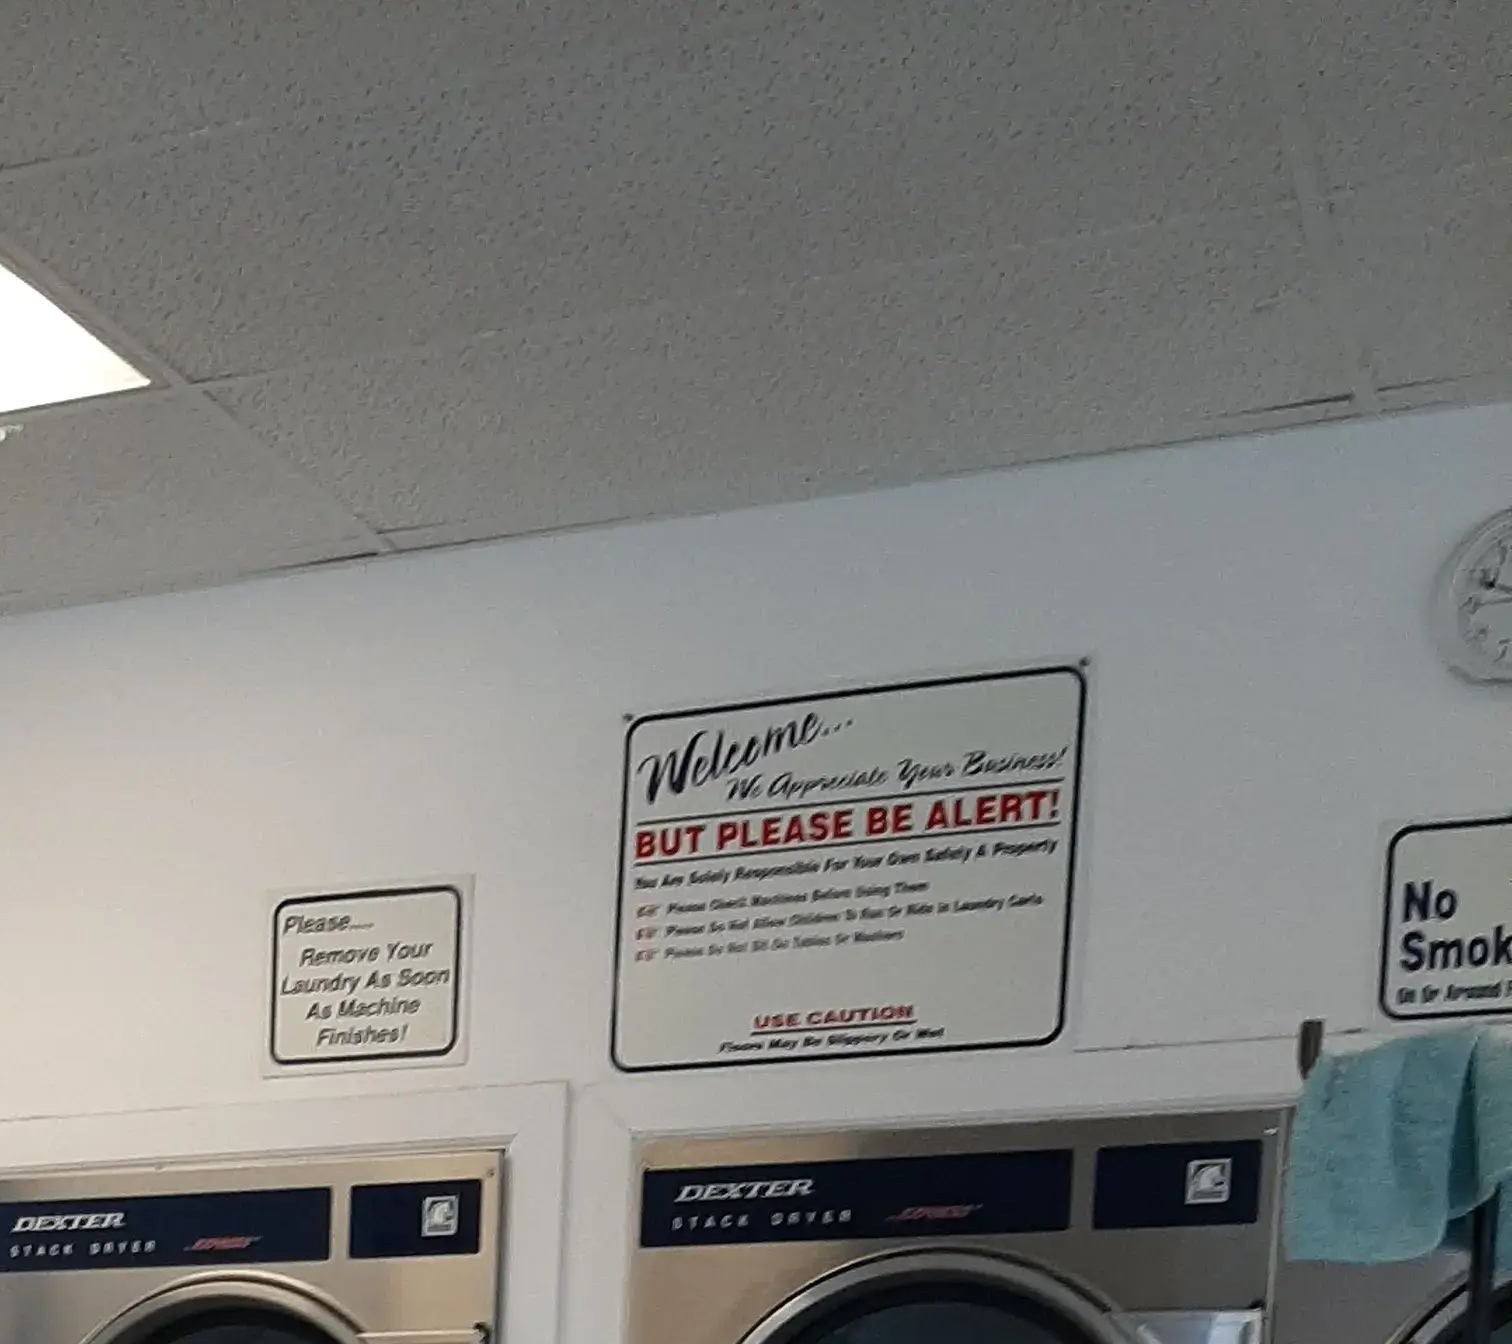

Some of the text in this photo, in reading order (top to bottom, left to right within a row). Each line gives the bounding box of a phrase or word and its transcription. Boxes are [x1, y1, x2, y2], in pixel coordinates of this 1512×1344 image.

[726, 746, 1069, 801] We Appreciate Your Business!
[635, 789, 1060, 859] BUT PLEASE BE ALERT!
[732, 860, 821, 881] Responsible
[823, 857, 849, 873] For
[852, 854, 884, 869] Your
[991, 839, 1059, 857] Property
[1402, 880, 1459, 922] No
[298, 941, 434, 968] Remove Your
[279, 967, 451, 997] Laundry As Soon
[304, 997, 421, 1021] As Machine
[753, 1004, 914, 1030] USE CAUTION
[315, 1022, 410, 1047] Finishes!
[826, 1033, 888, 1047] Slippery
[674, 1178, 816, 1203] DEXTER
[10, 1211, 127, 1233] DEXTER
